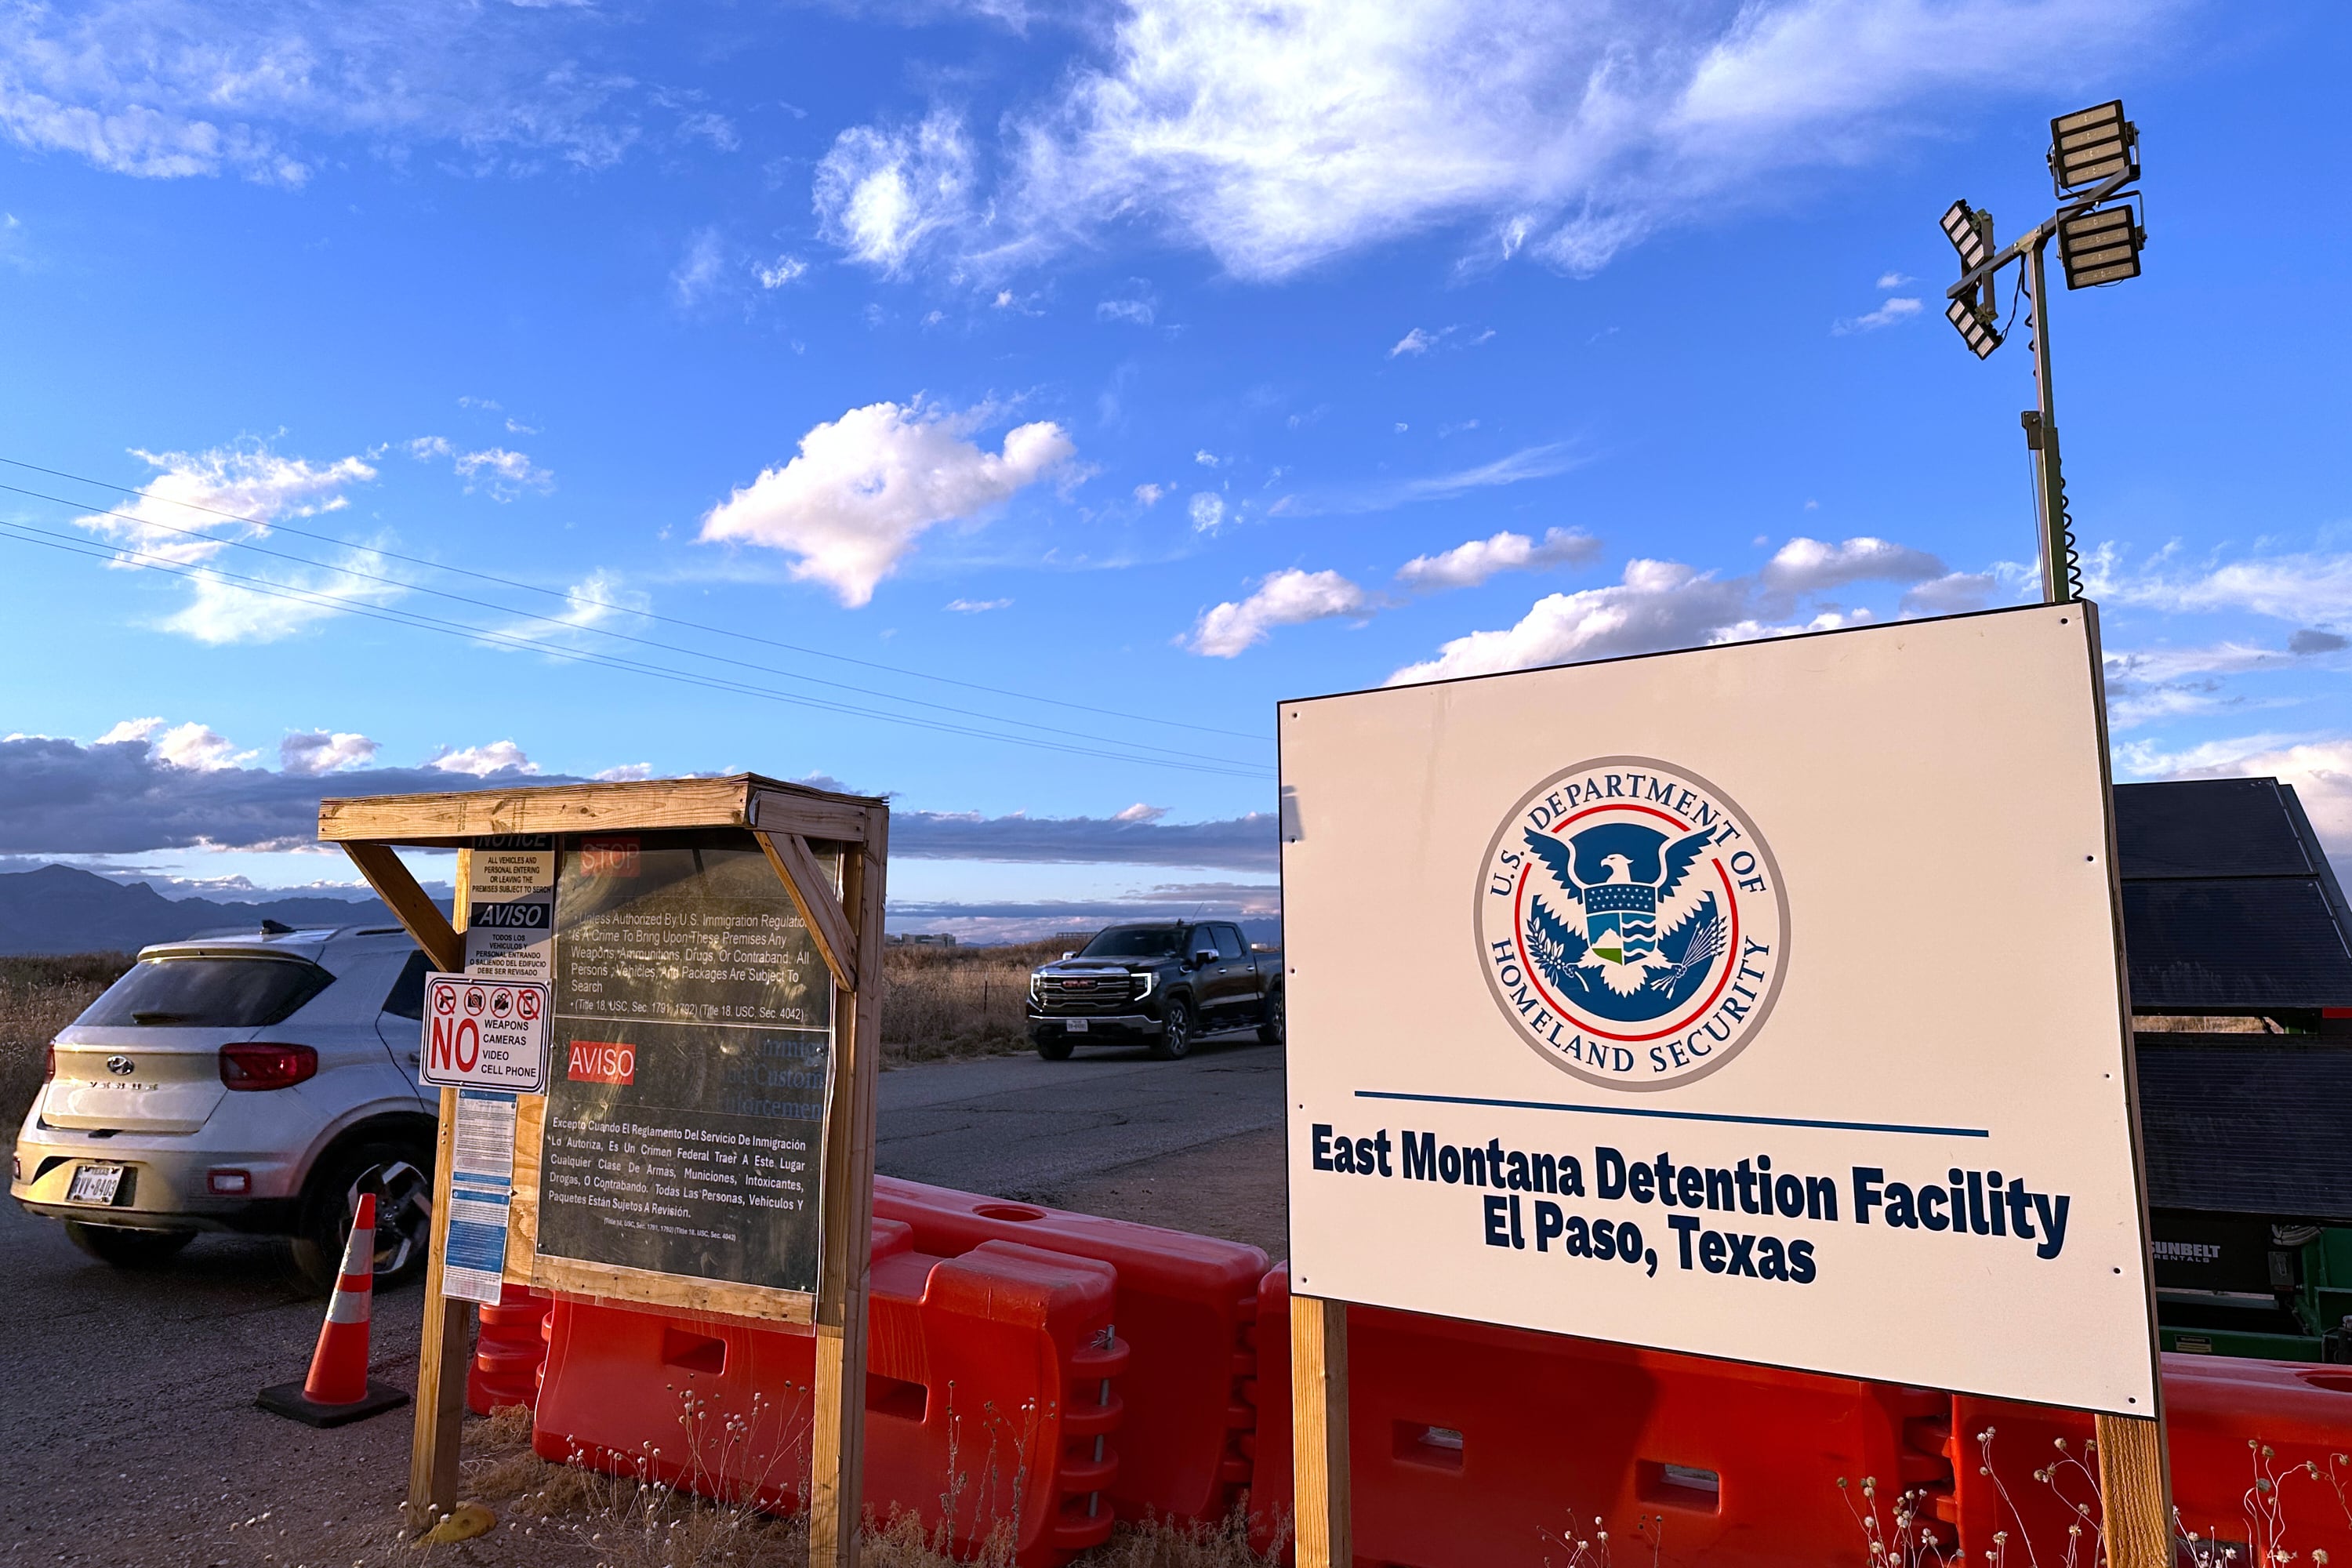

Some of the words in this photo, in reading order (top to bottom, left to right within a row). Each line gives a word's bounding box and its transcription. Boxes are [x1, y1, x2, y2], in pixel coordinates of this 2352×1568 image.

[1490, 849, 1525, 897] U.S.
[1527, 773, 1741, 848] DEPARTMENT
[1730, 851, 1766, 893] OF
[582, 844, 640, 869] STOP
[478, 905, 542, 927] AVISO
[579, 913, 611, 925] Unless
[612, 913, 662, 926] Authorized
[665, 913, 677, 928] By
[680, 913, 699, 925] U.S.
[702, 913, 757, 930] Immigration
[760, 914, 808, 931] Regulatio
[582, 930, 589, 941] A
[591, 929, 619, 942] Crime
[622, 930, 633, 942] To
[637, 930, 660, 946] Bring
[663, 931, 688, 946] Upon
[690, 931, 720, 943] These
[723, 931, 767, 946] Premises
[768, 933, 787, 949] Any
[571, 946, 617, 960] Weapons,
[619, 947, 682, 961] Ammunitions,
[685, 949, 715, 964] Drugs,
[720, 950, 731, 962] Or
[734, 950, 791, 964] Contraband.
[797, 952, 809, 964] All
[616, 964, 659, 978] Vehicles,
[660, 966, 680, 979] And
[682, 967, 728, 983] Packages
[729, 967, 746, 981] Are
[748, 967, 785, 983] Subject
[787, 969, 799, 983] To
[572, 980, 602, 993] Search
[575, 999, 594, 1011] (Title
[699, 1004, 718, 1018] (Title
[735, 1006, 757, 1019] USC,
[759, 1007, 778, 1018] Sec.
[780, 1007, 804, 1022] 4042)
[1491, 937, 1634, 1073] HOMELAND
[1650, 935, 1770, 1073] SECURITY
[485, 1019, 528, 1031] WEAPONS
[431, 1017, 480, 1073] NO
[483, 1033, 527, 1046] CAMERAS
[483, 1050, 510, 1061] VIDEO
[568, 1047, 635, 1077] AVISO
[481, 1064, 503, 1075] CELL
[506, 1066, 536, 1077] PHONE
[553, 1117, 586, 1130] Excepto
[588, 1120, 620, 1134] Cuando
[622, 1123, 630, 1134] El
[632, 1124, 682, 1140] Reglamento
[684, 1129, 699, 1140] Del
[701, 1131, 735, 1145] Servicio
[739, 1134, 750, 1145] De
[753, 1135, 806, 1151] Inmigración
[551, 1136, 562, 1146] Lo
[566, 1137, 604, 1152] Autoriza,
[608, 1141, 619, 1152] Es
[624, 1143, 635, 1154] Un
[641, 1145, 671, 1157] Crimen
[677, 1148, 710, 1162] Federal
[715, 1151, 737, 1164] Traer
[742, 1154, 749, 1165] A
[754, 1156, 775, 1168] Este
[780, 1157, 806, 1173] Lugar
[550, 1154, 591, 1168] Cualquier
[597, 1159, 622, 1171] Clase
[629, 1162, 640, 1174] De
[646, 1164, 677, 1179] Armas,
[684, 1167, 737, 1185] Municiones,
[745, 1174, 804, 1193] Intoxicantes,
[550, 1171, 581, 1186] Drogas,
[584, 1176, 591, 1185] O
[593, 1177, 649, 1193] Contrabando.
[655, 1184, 681, 1197] Todas
[684, 1187, 699, 1198] Las
[702, 1189, 745, 1207] Personas,
[797, 1200, 804, 1210] Y
[1312, 1123, 1392, 1178] East
[1402, 1131, 1584, 1198] Montana
[1595, 1147, 1838, 1221] Detention
[1853, 1167, 2070, 1260] Facility
[549, 1190, 586, 1204] Paquetes
[588, 1195, 611, 1208] Están
[612, 1198, 643, 1212] Sujetos
[644, 1202, 651, 1212] A
[652, 1203, 691, 1218] Revisión.
[1484, 1195, 1526, 1250] El
[1535, 1200, 1657, 1279] Paso,
[1668, 1214, 1817, 1284] Texas
[2154, 1254, 2209, 1263] RENTALS
